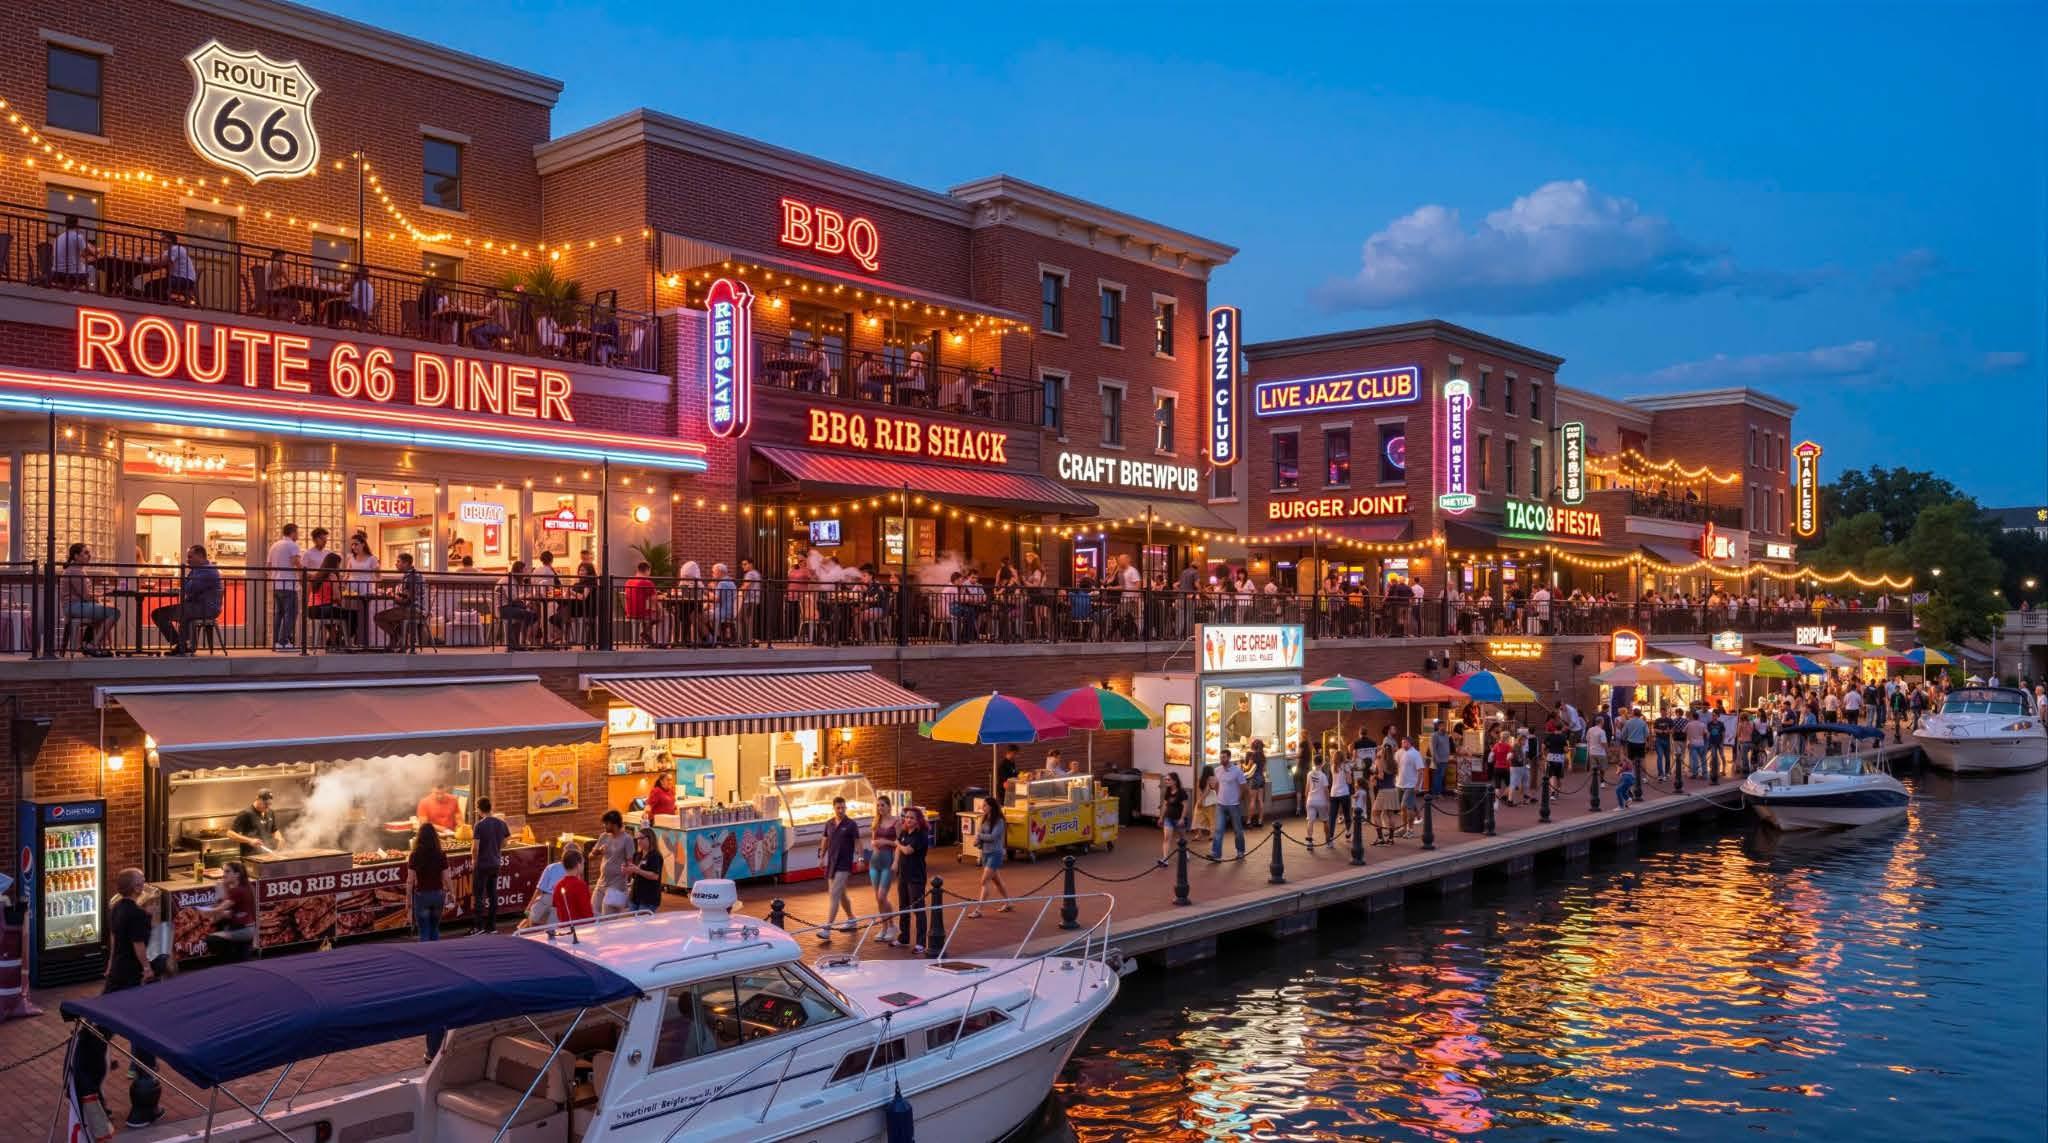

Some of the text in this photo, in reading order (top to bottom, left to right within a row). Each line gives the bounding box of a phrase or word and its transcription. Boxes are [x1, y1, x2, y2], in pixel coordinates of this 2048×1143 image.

[213, 60, 297, 98] ROUTE
[213, 97, 299, 162] 66
[781, 199, 879, 271] BBQ
[77, 307, 575, 422] ROUTE 66 DINER
[1215, 313, 1229, 457] JAZZ CLUB
[1261, 374, 1412, 409] LIVE JAZZ CLUB
[809, 408, 1007, 464] BBQ RIB SHACK
[1059, 452, 1199, 492] CRAFT BREWPUB
[1269, 498, 1344, 520] BURGER
[1233, 633, 1278, 652] ICE CREAM
[265, 867, 401, 898] BBQ RIB SHACK
